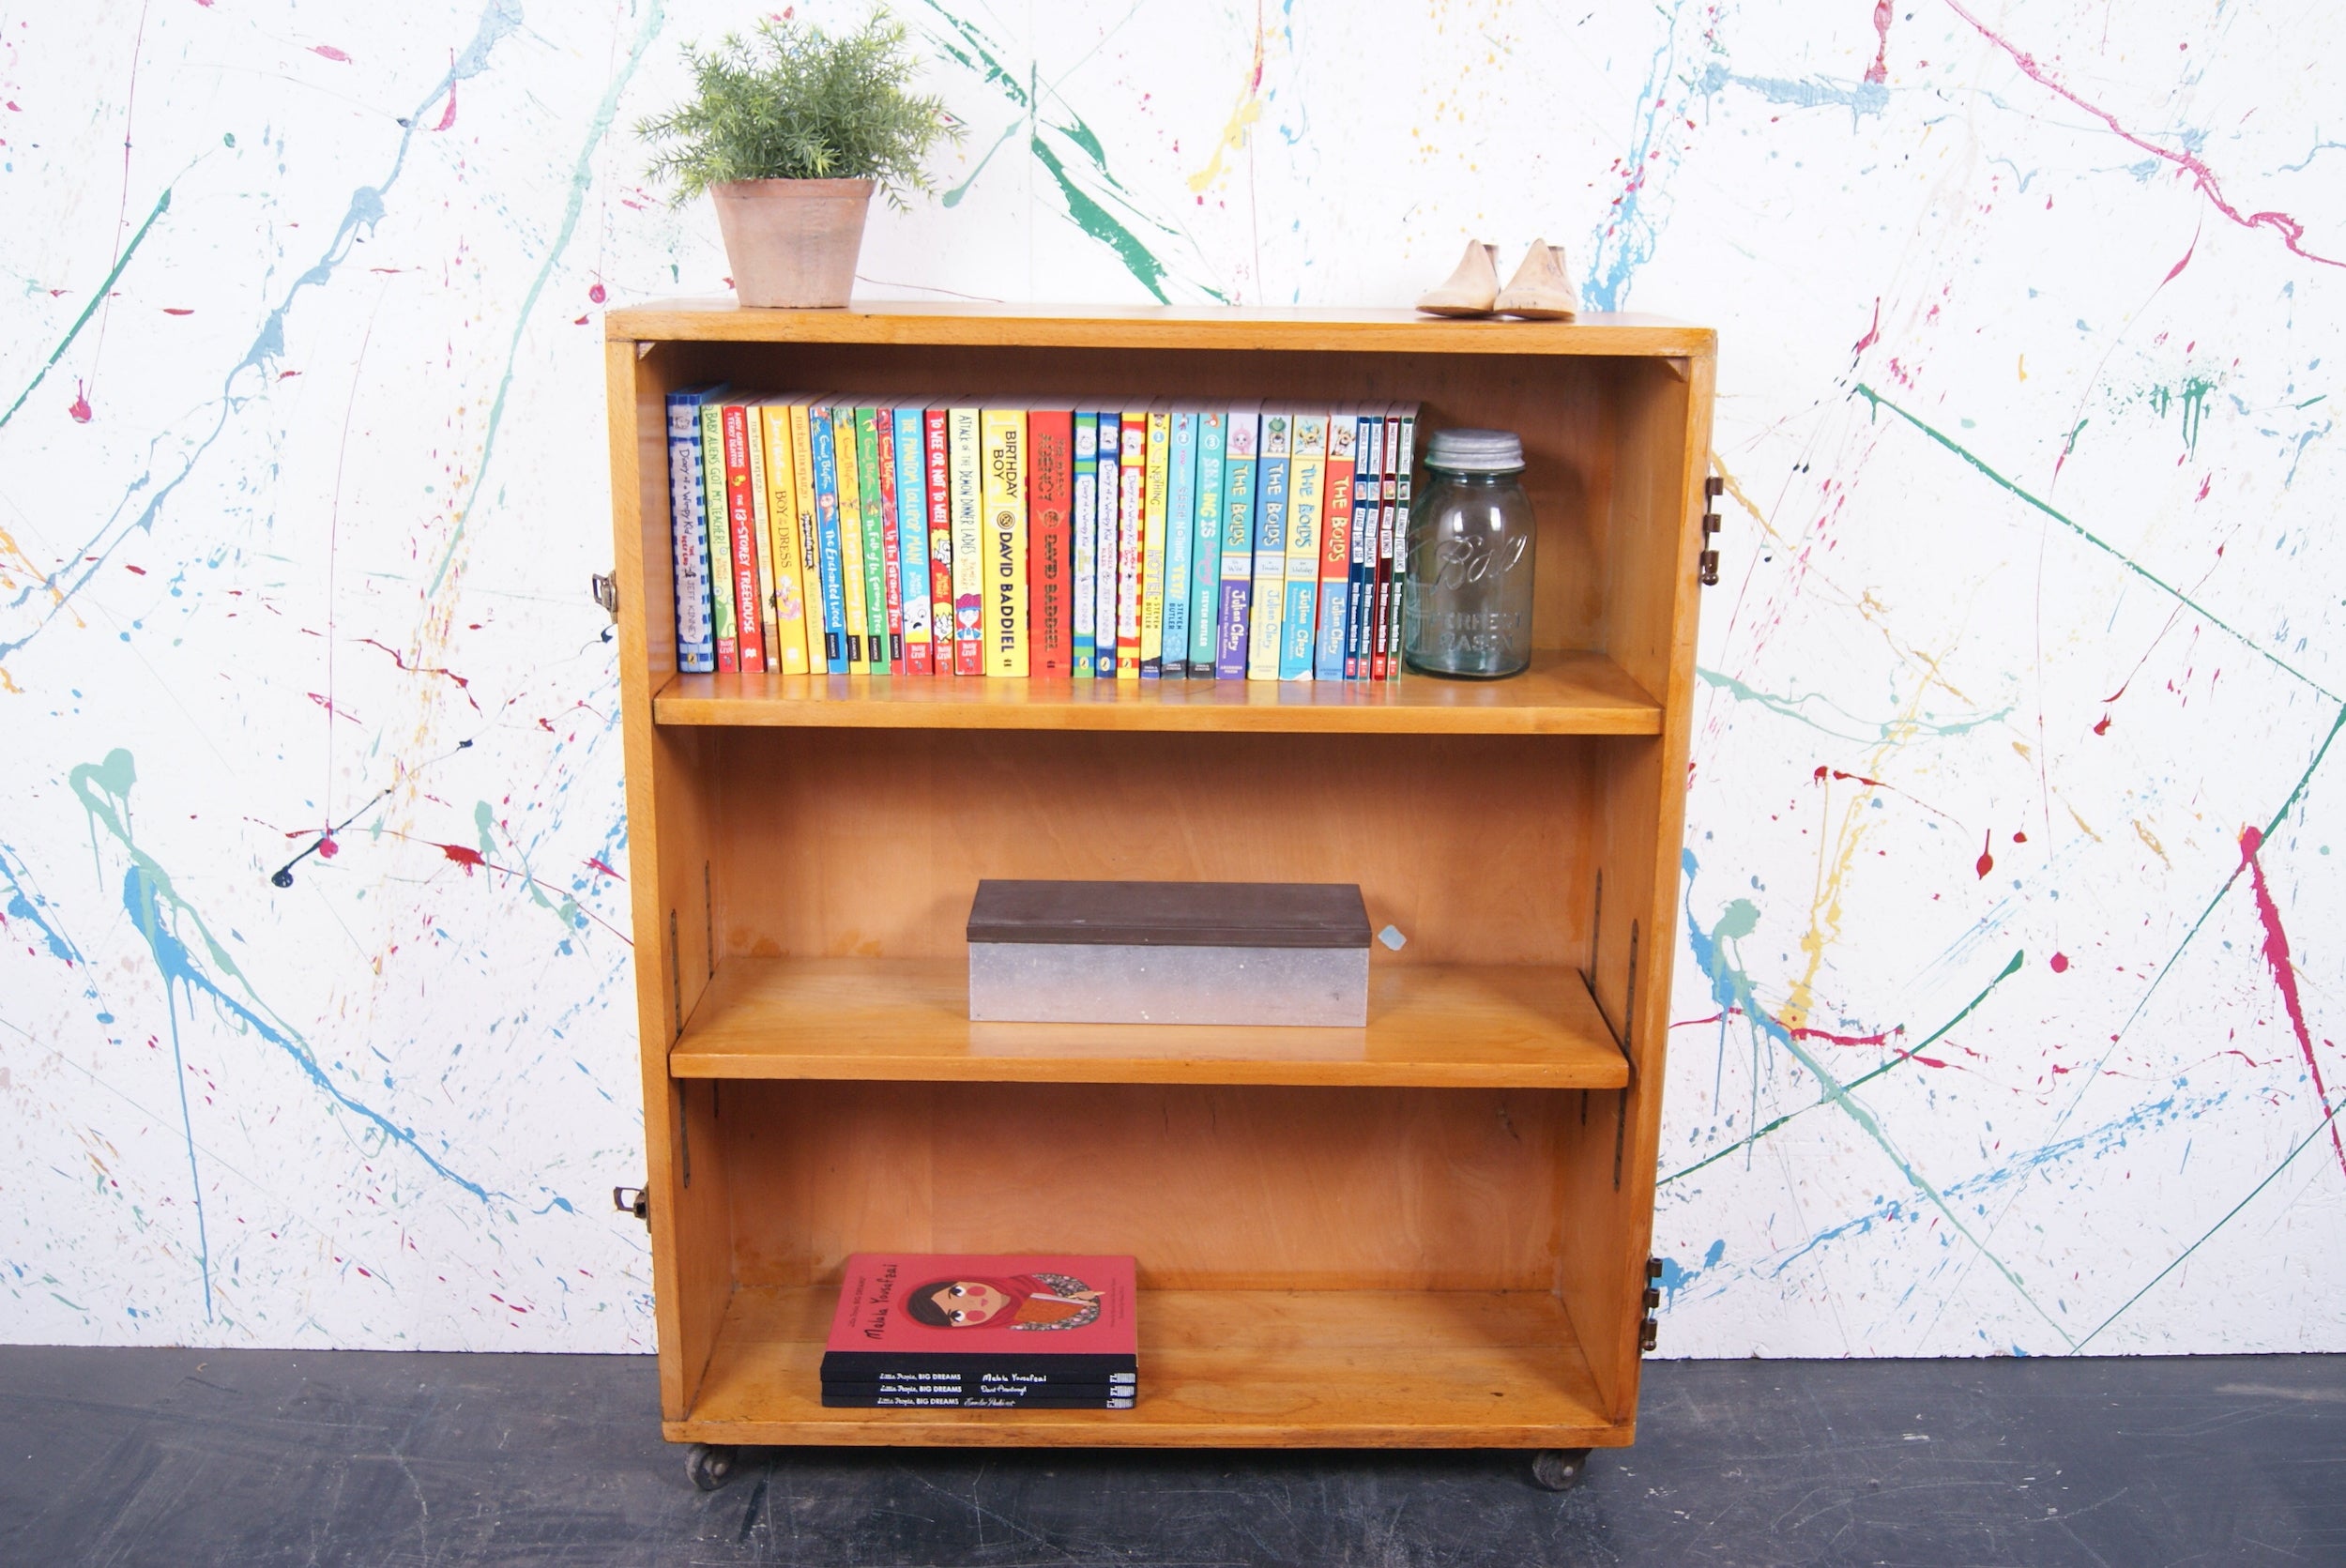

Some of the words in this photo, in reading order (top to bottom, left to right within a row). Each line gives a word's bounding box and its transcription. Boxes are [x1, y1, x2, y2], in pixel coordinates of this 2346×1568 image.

[706, 412, 718, 433] BABY
[902, 416, 917, 434] THE
[959, 415, 971, 441] ATTACK
[707, 435, 720, 465] ALIENS
[818, 434, 830, 461] Enid
[930, 431, 944, 449] WEE
[679, 449, 690, 476] Diary
[902, 437, 920, 484] PHANTOM
[931, 452, 945, 467] OR
[960, 455, 971, 466] THE
[993, 449, 1004, 480] BOY
[1005, 431, 1018, 498] BIRTHDAY
[1037, 433, 1054, 502] AGENCY
[709, 466, 722, 486] GOT
[821, 460, 832, 490] Blyton
[932, 469, 946, 488] NOT
[959, 470, 973, 495] DEMON
[1104, 464, 1114, 488] Diary
[1127, 475, 1136, 495] Diary
[1231, 463, 1249, 496] THE
[1268, 461, 1285, 495] THE
[1299, 464, 1317, 497] THE
[711, 490, 723, 502] MY
[775, 490, 788, 517] BOY
[1081, 480, 1090, 501] Diary
[1333, 476, 1349, 510] THE
[681, 493, 692, 521] Wimpy
[905, 487, 922, 533] LOLLIPOP
[960, 498, 975, 525] DINNER
[1103, 502, 1112, 527] Wimpy
[683, 521, 693, 534] Kid
[711, 506, 725, 544] TEACHER!
[1104, 527, 1112, 541] Kid
[1126, 510, 1135, 534] Wimpy
[1200, 520, 1217, 538] IS
[1227, 502, 1248, 546] BOLDS
[1263, 502, 1284, 546] BOLDS
[1295, 504, 1314, 548] BOLDS
[778, 526, 792, 569] DRESS
[826, 529, 836, 545] The
[868, 530, 879, 551] Folk
[906, 535, 924, 566] MAN!
[960, 528, 976, 555] LADIES
[1328, 516, 1348, 562] BOLDS
[1382, 531, 1391, 555] VIKINGS
[999, 532, 1013, 578] DAVID
[1044, 534, 1059, 580] DAVID
[825, 546, 840, 600] Enchanted
[887, 561, 899, 605] Faraway
[1146, 549, 1163, 600] HOTEL
[687, 580, 695, 601] JEFF
[739, 571, 754, 633] TREEHOUSE
[869, 575, 881, 612] Faraway
[1201, 590, 1210, 617] STEVEN
[829, 601, 842, 628] Wood
[889, 607, 899, 629] Tree
[999, 584, 1014, 653] BADDIEL
[1044, 584, 1059, 652] BADDIEL
[1231, 589, 1246, 622] Julian
[1266, 590, 1281, 623] Julian
[1298, 589, 1312, 624] Julian
[1332, 597, 1346, 630] Julian
[688, 605, 696, 639] KINNEY
[873, 613, 882, 634] Tree
[1102, 607, 1110, 641] KINNEY
[1199, 617, 1209, 647] BUTLER
[1262, 622, 1278, 649] Clary
[1227, 623, 1245, 651] Clary
[1295, 629, 1310, 658] Clary
[1328, 630, 1344, 654] Clary
[870, 1264, 898, 1303] Yousafzai
[863, 1308, 889, 1340] Malala
[983, 1373, 1009, 1381] Malala
